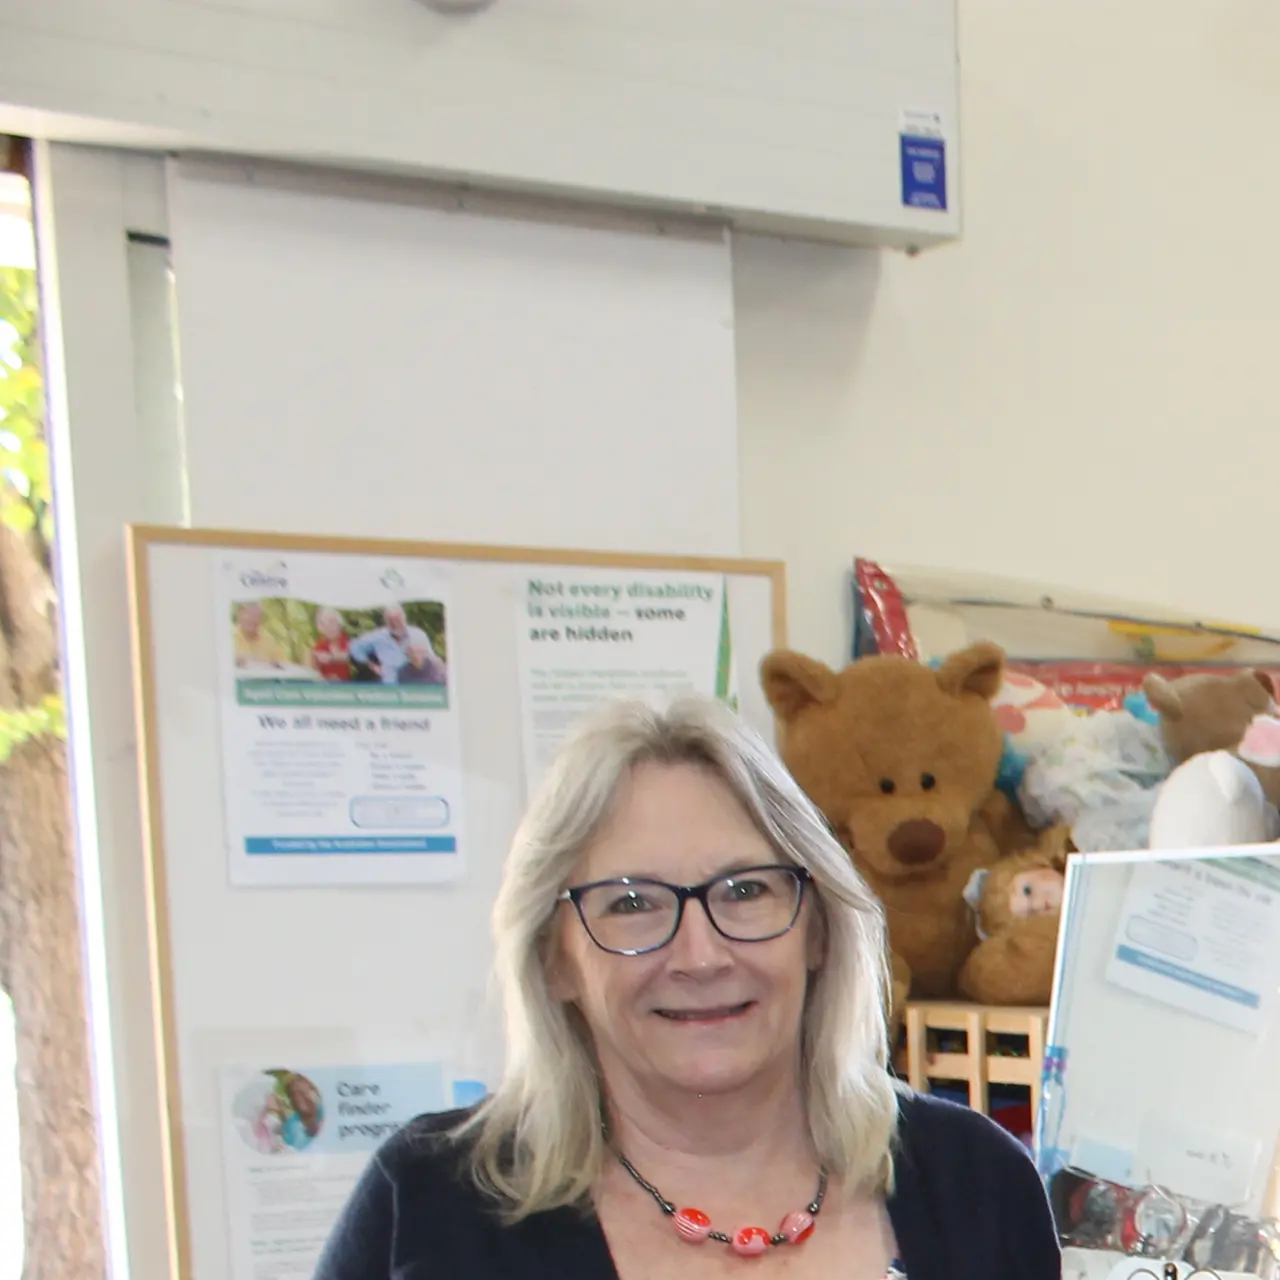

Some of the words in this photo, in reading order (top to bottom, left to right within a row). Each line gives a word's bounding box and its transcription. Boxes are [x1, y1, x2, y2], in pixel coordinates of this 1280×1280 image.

[527, 580, 564, 597] Not
[568, 583, 621, 602] every
[626, 581, 714, 603] disability
[528, 603, 543, 618] is
[549, 603, 610, 619] visible
[635, 607, 687, 621] some
[529, 628, 561, 641] are
[565, 626, 634, 642] hidden
[257, 715, 287, 730] We
[293, 715, 312, 730] all
[316, 716, 361, 730] need
[366, 719, 376, 730] a
[380, 715, 431, 731] friend
[336, 1081, 380, 1097] Care
[338, 1101, 392, 1116] finder
